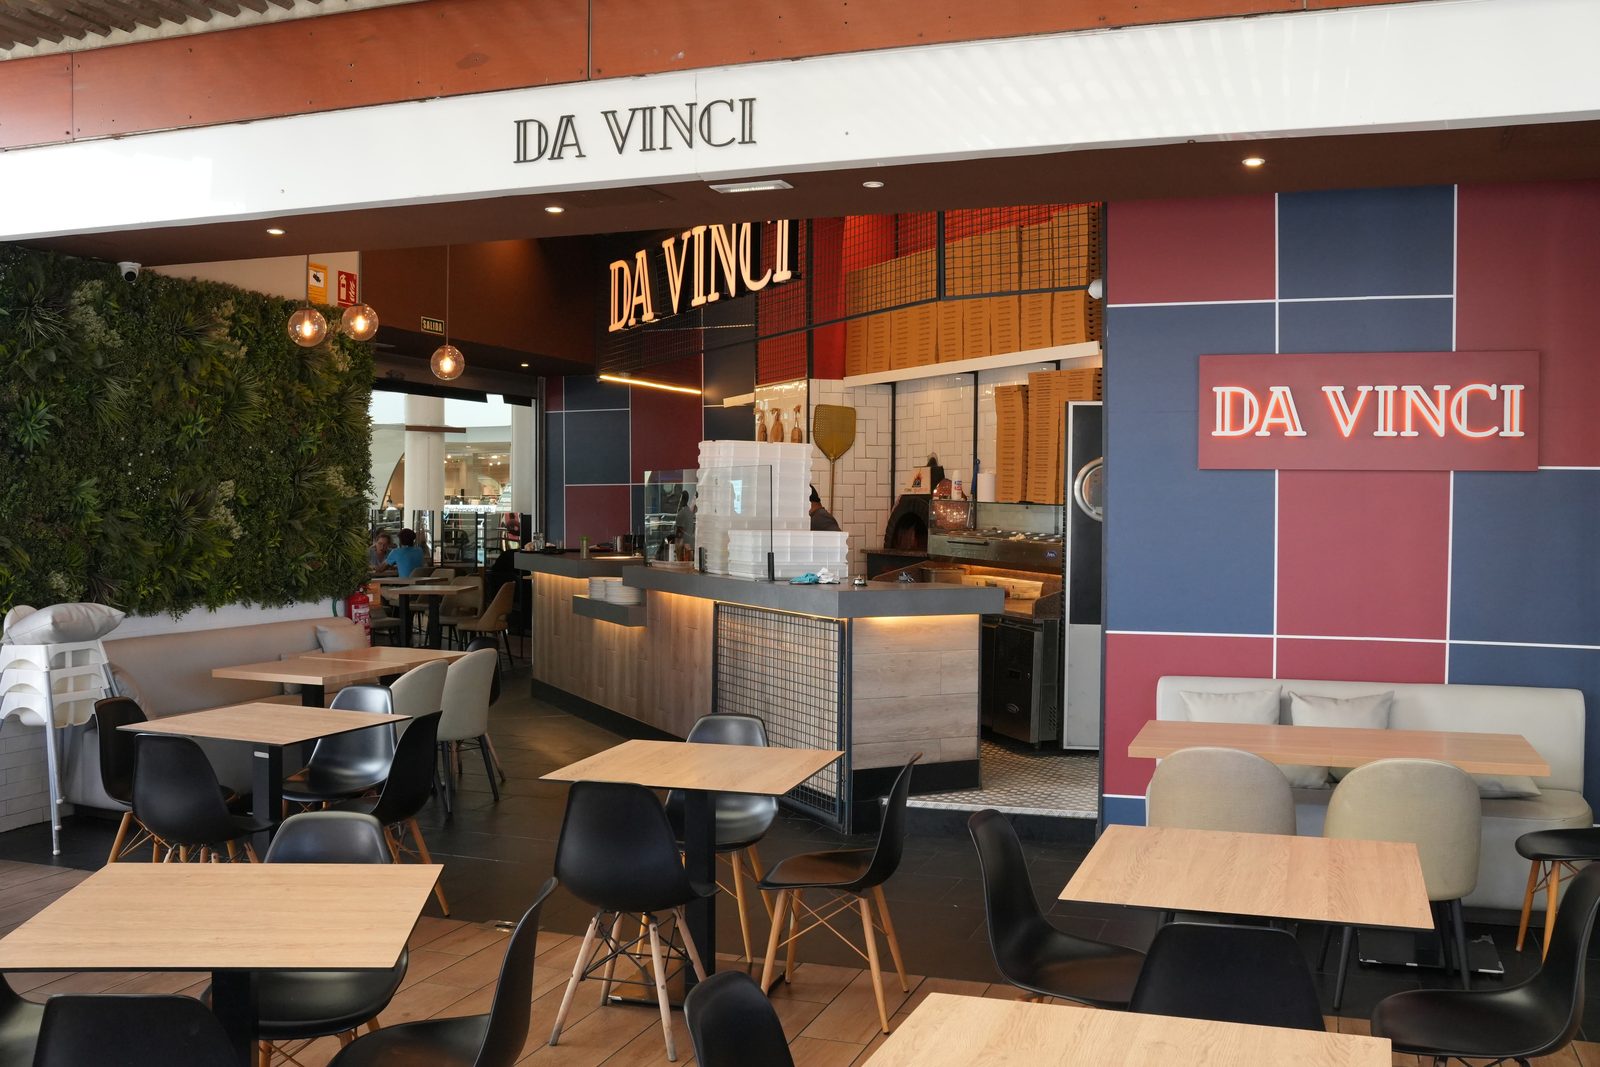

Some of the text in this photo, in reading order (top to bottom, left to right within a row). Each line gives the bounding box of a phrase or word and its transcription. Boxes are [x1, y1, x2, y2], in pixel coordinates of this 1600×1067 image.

[513, 98, 757, 164] DA VINCI
[608, 219, 792, 332] DA VINCI
[422, 319, 443, 333] SALIDA
[1211, 383, 1525, 438] DA VINCI
